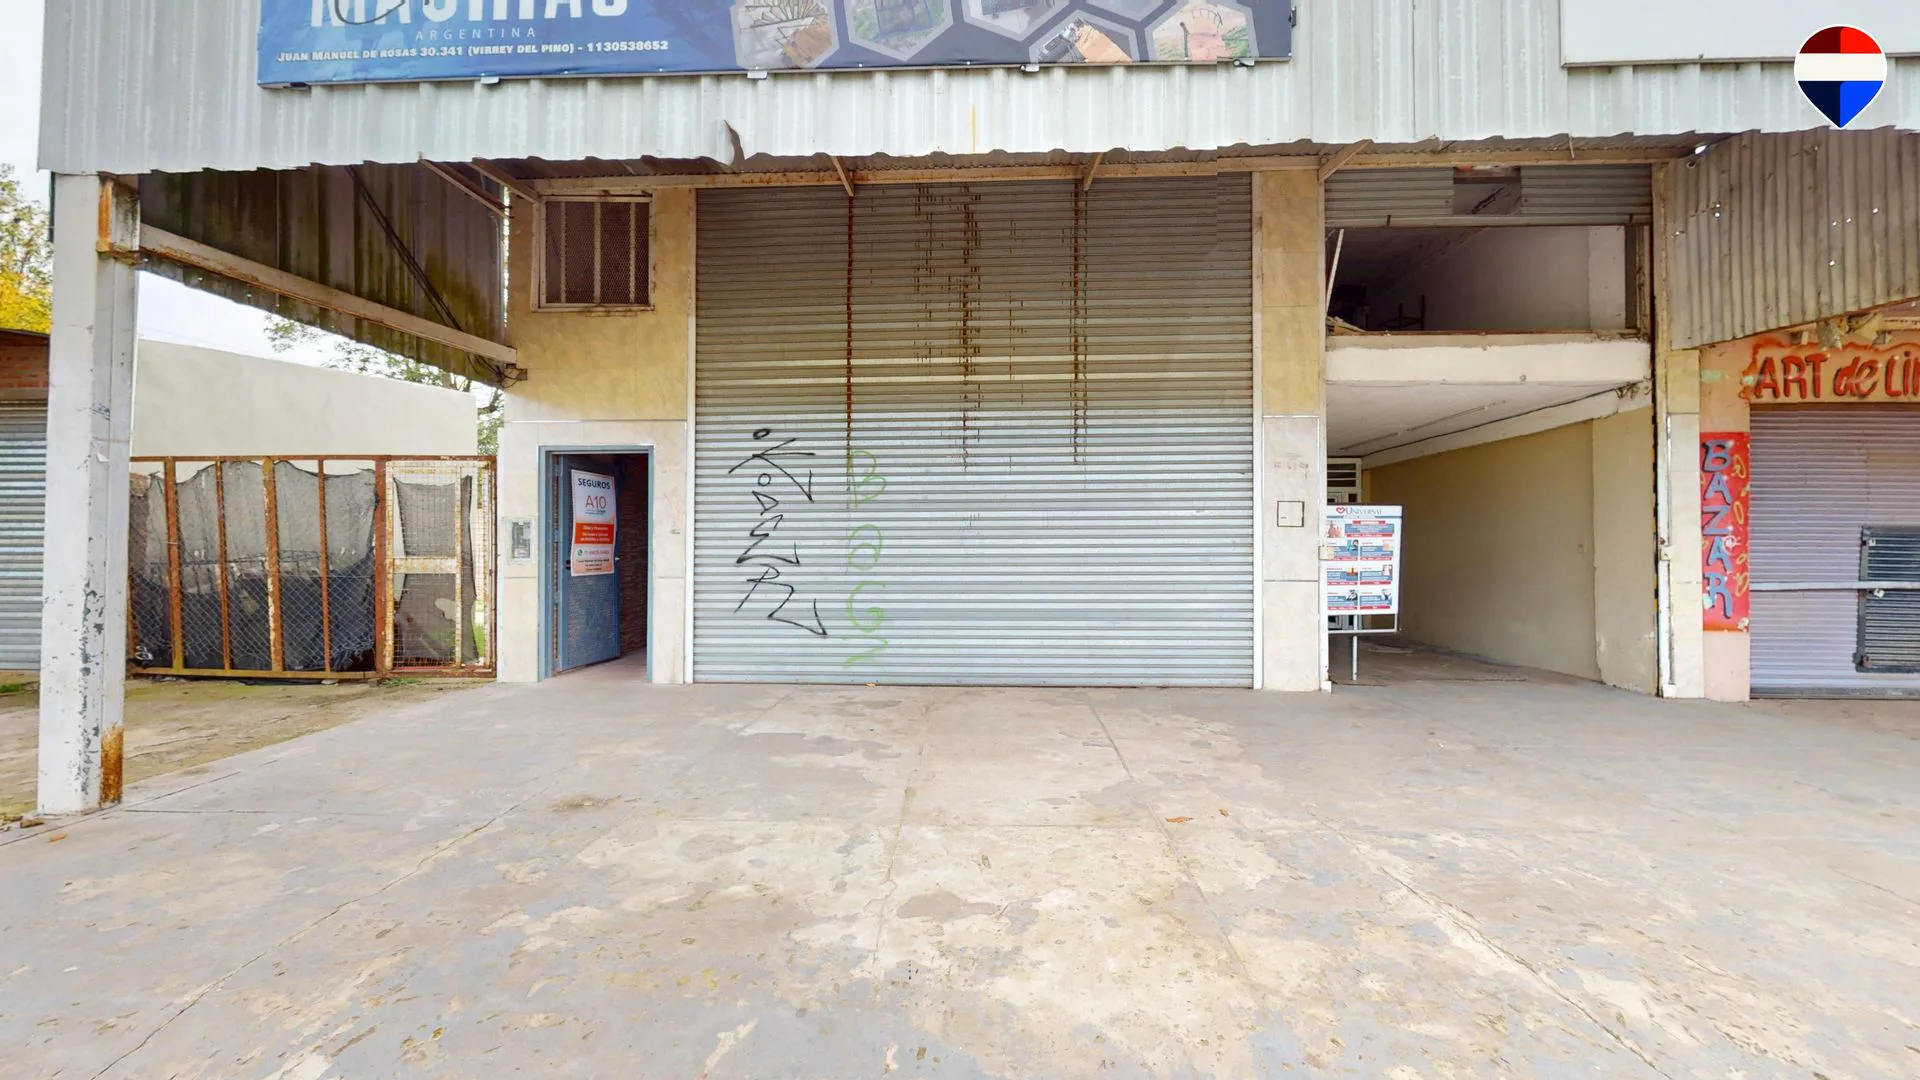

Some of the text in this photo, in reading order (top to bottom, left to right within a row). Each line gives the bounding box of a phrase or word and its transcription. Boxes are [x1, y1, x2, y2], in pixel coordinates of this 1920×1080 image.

[415, 27, 536, 41] ARGENTINA
[278, 51, 309, 62] JUAN
[312, 50, 360, 61] MANUEL
[363, 51, 377, 59] DE
[420, 46, 463, 57] 30.341
[517, 44, 538, 54] DEL
[541, 43, 575, 54] PINO)
[587, 40, 669, 52] 1130538652
[1754, 352, 1828, 399] ART
[577, 477, 611, 490] SEGUROS
[585, 495, 607, 509] A10
[1702, 439, 1732, 619] BAZAR
